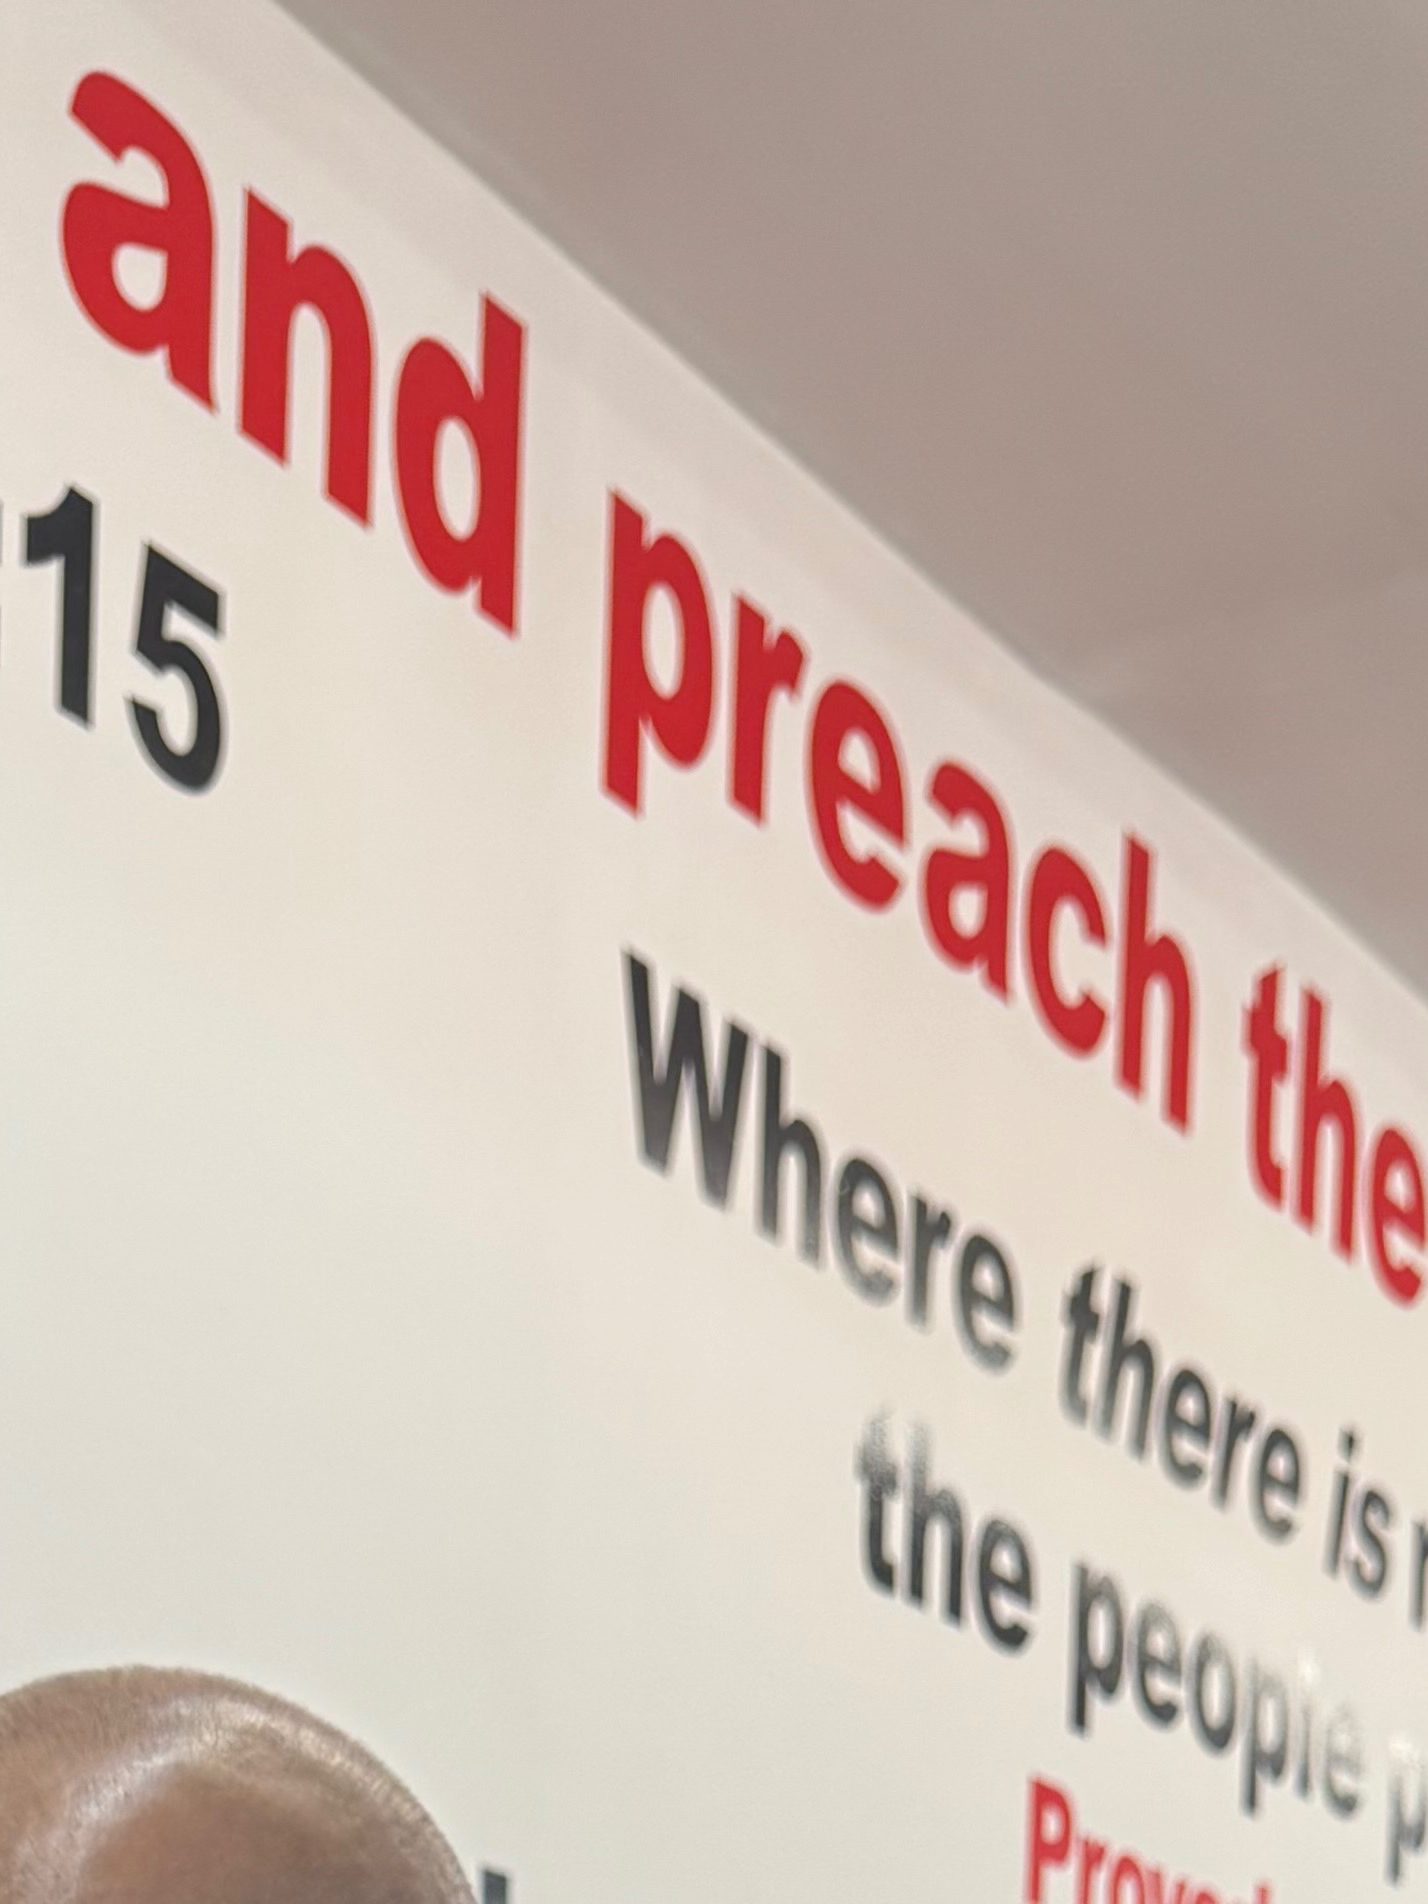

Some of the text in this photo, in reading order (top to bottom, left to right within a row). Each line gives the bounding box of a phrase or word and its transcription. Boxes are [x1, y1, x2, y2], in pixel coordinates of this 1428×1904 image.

[61, 69, 527, 638] and
[601, 488, 1199, 1136] preach
[624, 947, 1019, 1373] Where
[1060, 1263, 1302, 1545] there
[1327, 1427, 1392, 1598] is
[855, 1411, 1035, 1655] the
[1068, 1561, 1361, 1817] people
